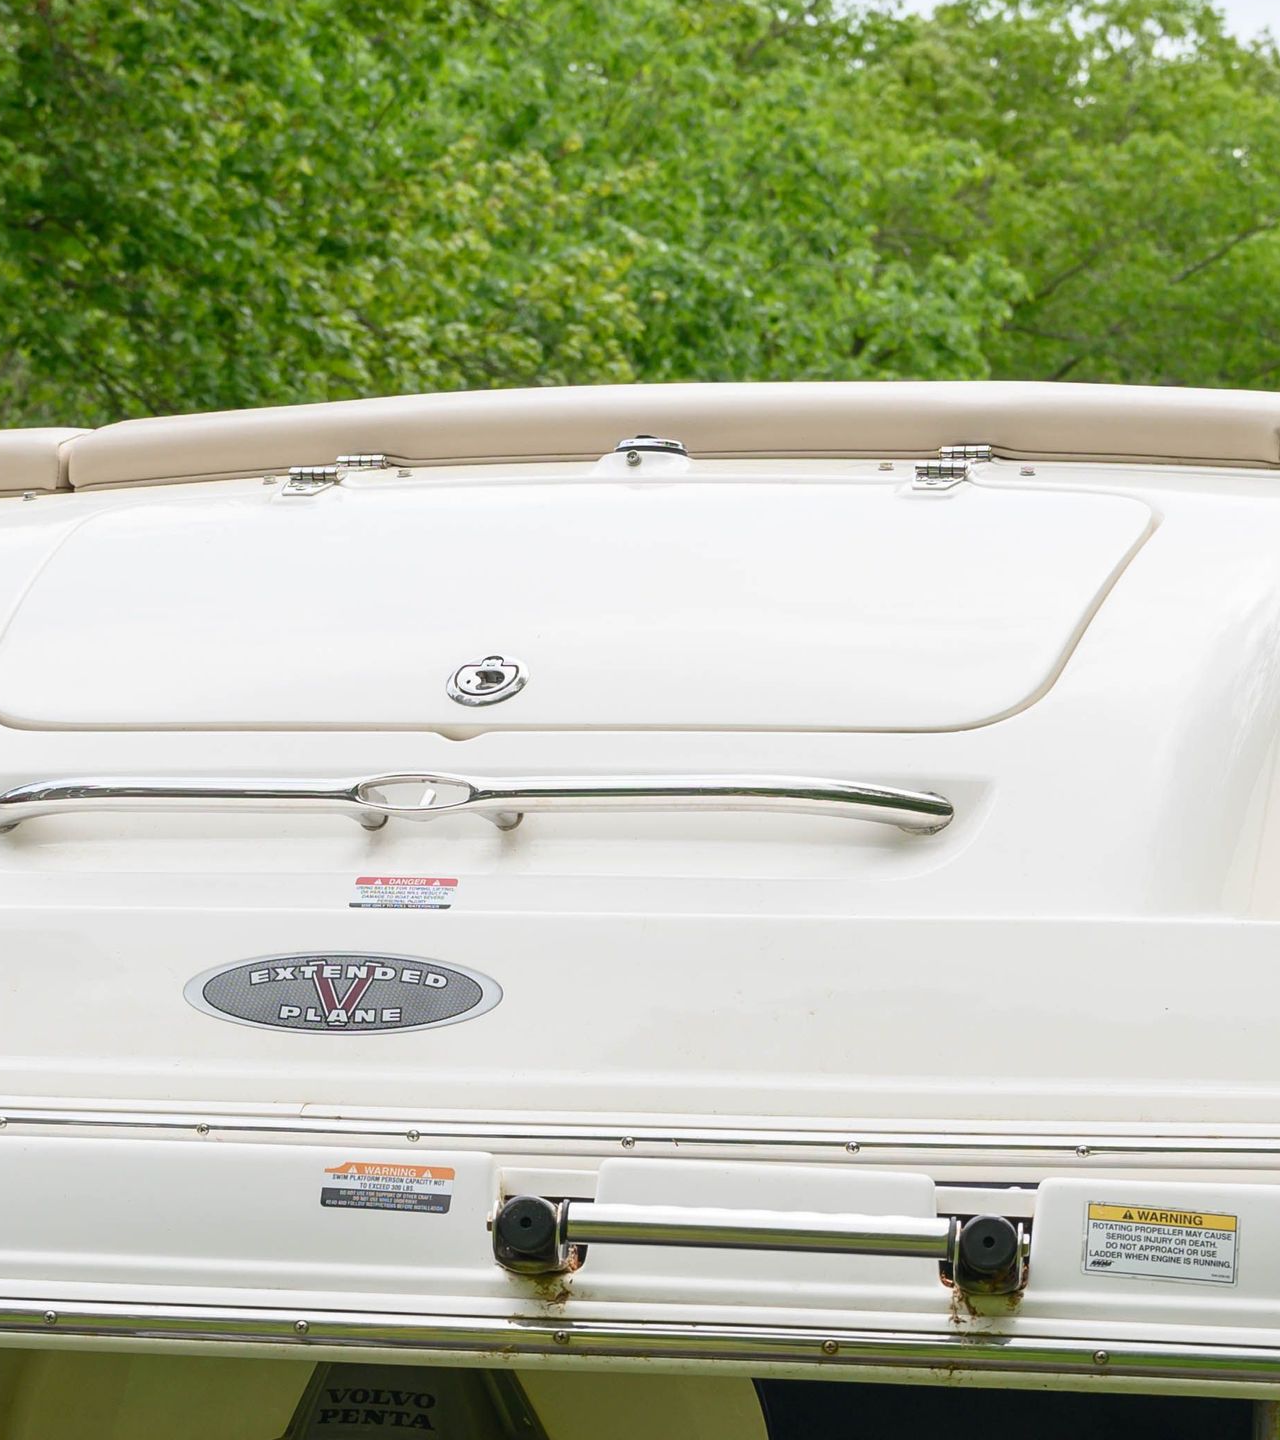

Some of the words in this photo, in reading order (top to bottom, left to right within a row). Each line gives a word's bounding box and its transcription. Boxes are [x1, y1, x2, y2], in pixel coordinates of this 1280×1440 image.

[388, 878, 427, 886] DANGER
[249, 964, 449, 989] EXTENDED
[278, 1005, 402, 1023] PLANE
[364, 1166, 416, 1176] WARNING
[350, 1174, 380, 1182] PLATFORM
[381, 1176, 404, 1184] PERSON
[405, 1178, 432, 1186] CAPACITY
[368, 1182, 390, 1190] EXCEED
[1138, 1210, 1203, 1226] WARNING
[1092, 1222, 1134, 1232] ROTATING
[1134, 1225, 1183, 1237] PROPELLER
[1185, 1230, 1203, 1238] MAY
[1204, 1231, 1232, 1241] CAUSE
[1106, 1232, 1141, 1242] SERIOUS
[1144, 1235, 1173, 1245] INJURY
[1174, 1238, 1186, 1246] OR
[1188, 1239, 1217, 1249] DEATH.
[1090, 1249, 1122, 1259] LADDER
[1124, 1252, 1149, 1261] WHEN
[1151, 1254, 1181, 1264] ENGINE
[1183, 1257, 1191, 1265] IS
[1193, 1258, 1232, 1269] RUNNING.
[1120, 1243, 1137, 1251] NOT
[1140, 1244, 1184, 1255] APPROACH
[1186, 1248, 1198, 1256] OR
[1200, 1250, 1217, 1258] USE
[325, 1388, 436, 1409] VOLVO
[318, 1408, 436, 1431] PENTA
